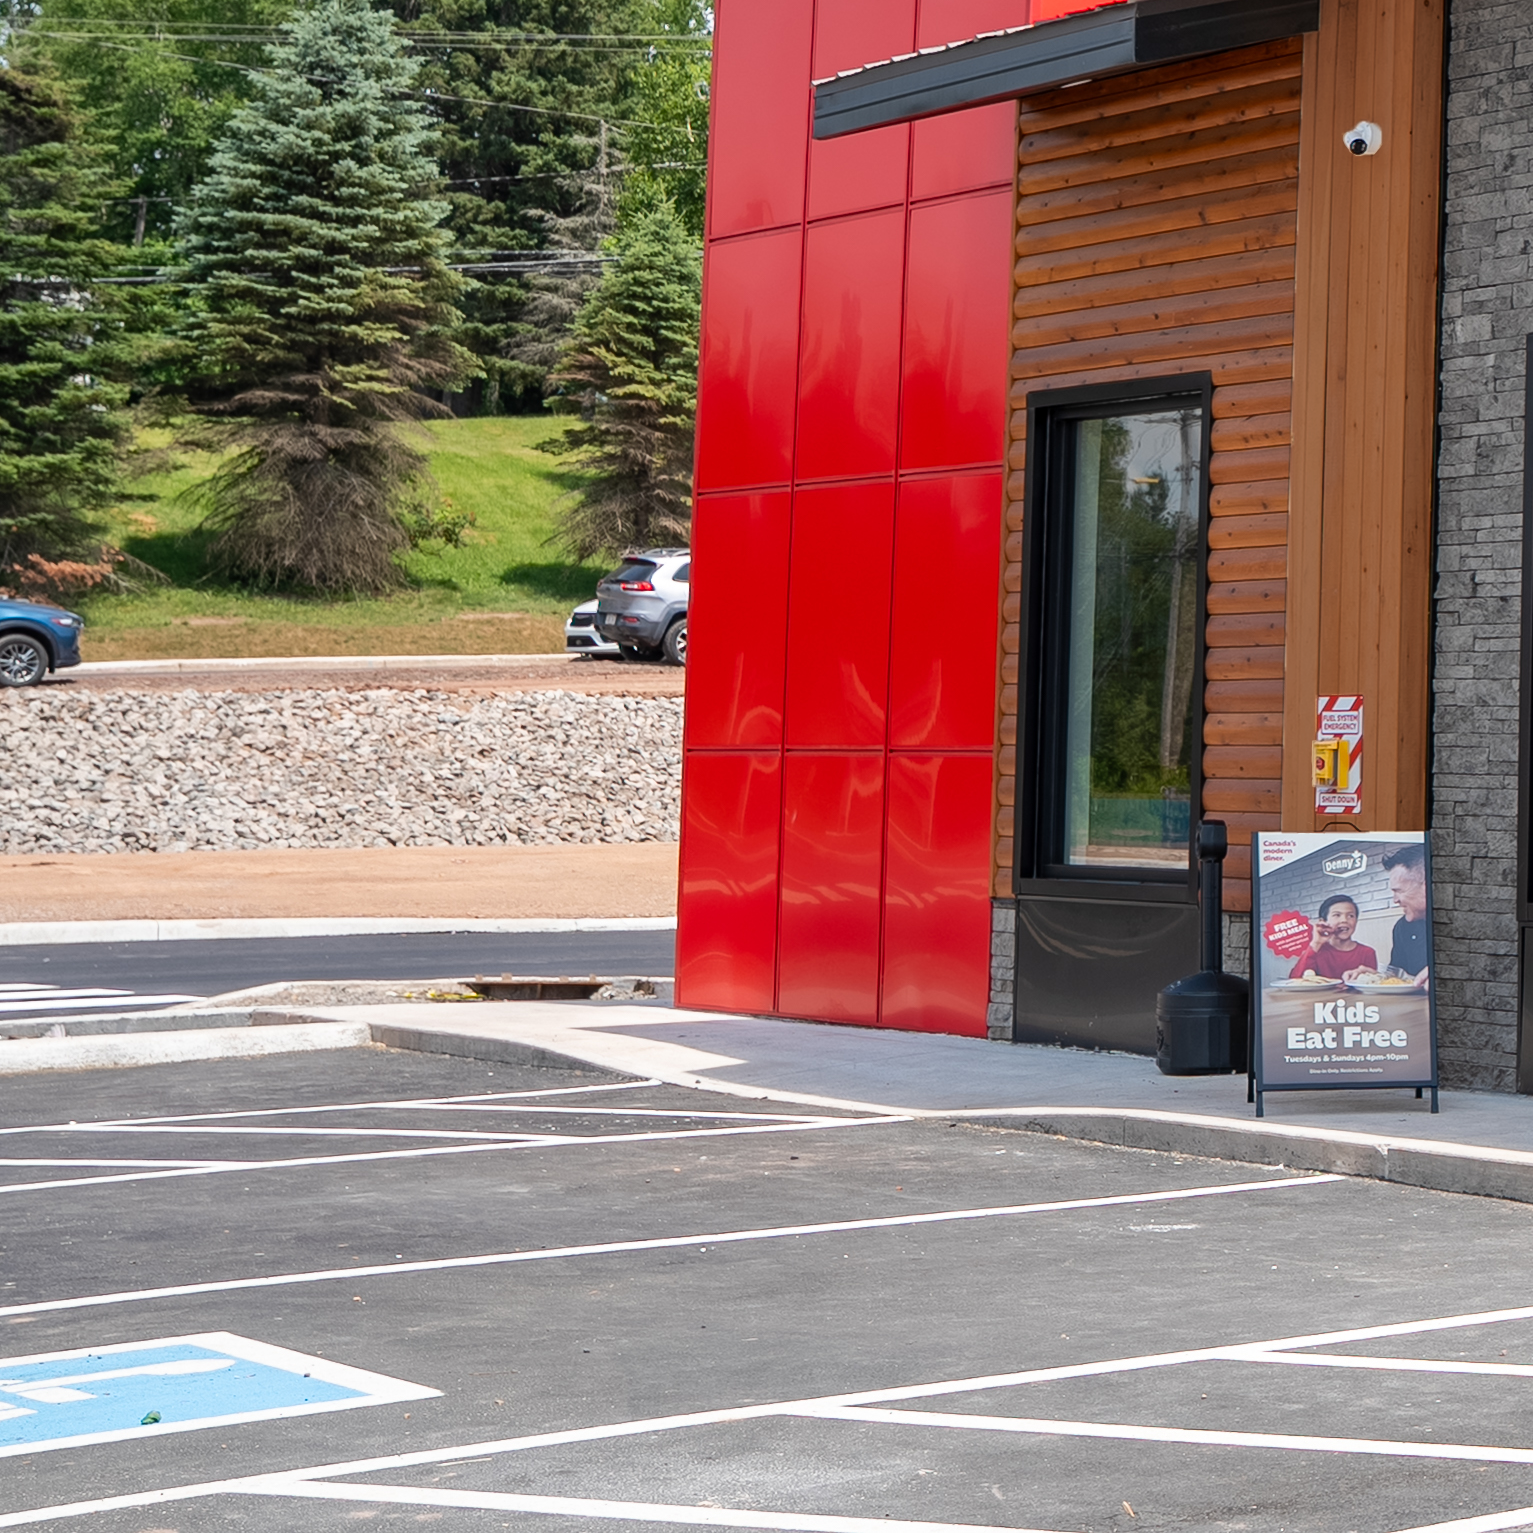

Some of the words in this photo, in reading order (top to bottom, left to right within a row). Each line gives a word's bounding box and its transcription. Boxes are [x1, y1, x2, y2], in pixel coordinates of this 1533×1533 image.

[1325, 851, 1361, 872] Denny's
[1268, 930, 1288, 941] KIDS
[1287, 923, 1309, 935] MEAL
[1273, 918, 1299, 932] FREE
[1314, 998, 1380, 1024] Kids
[1287, 1027, 1338, 1049] Eat
[1343, 1026, 1408, 1048] Free
[1284, 1055, 1321, 1063] Tuesdays
[1322, 1054, 1330, 1062] &
[1331, 1054, 1364, 1063] Sundays
[1366, 1053, 1409, 1062] 4pm-10pm
